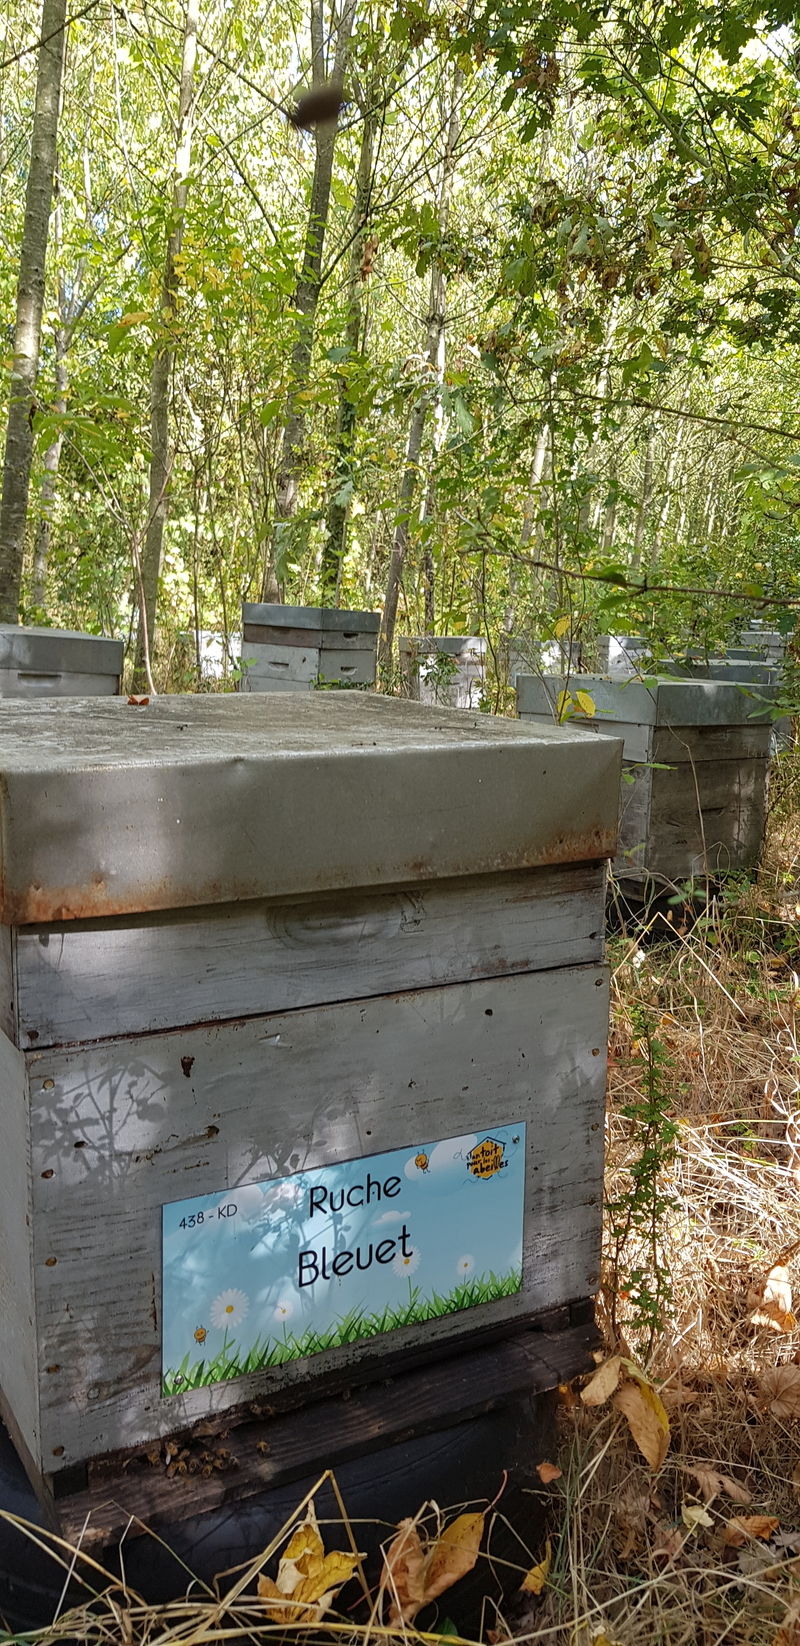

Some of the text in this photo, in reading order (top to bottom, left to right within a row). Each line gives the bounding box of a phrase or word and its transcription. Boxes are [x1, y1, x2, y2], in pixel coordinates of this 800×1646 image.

[480, 1143, 499, 1158] toit
[473, 1156, 509, 1175] abeilles
[309, 1173, 402, 1218] Ruche
[179, 1211, 205, 1230] 438
[217, 1204, 238, 1220] KD
[298, 1224, 414, 1288] Bleuet
